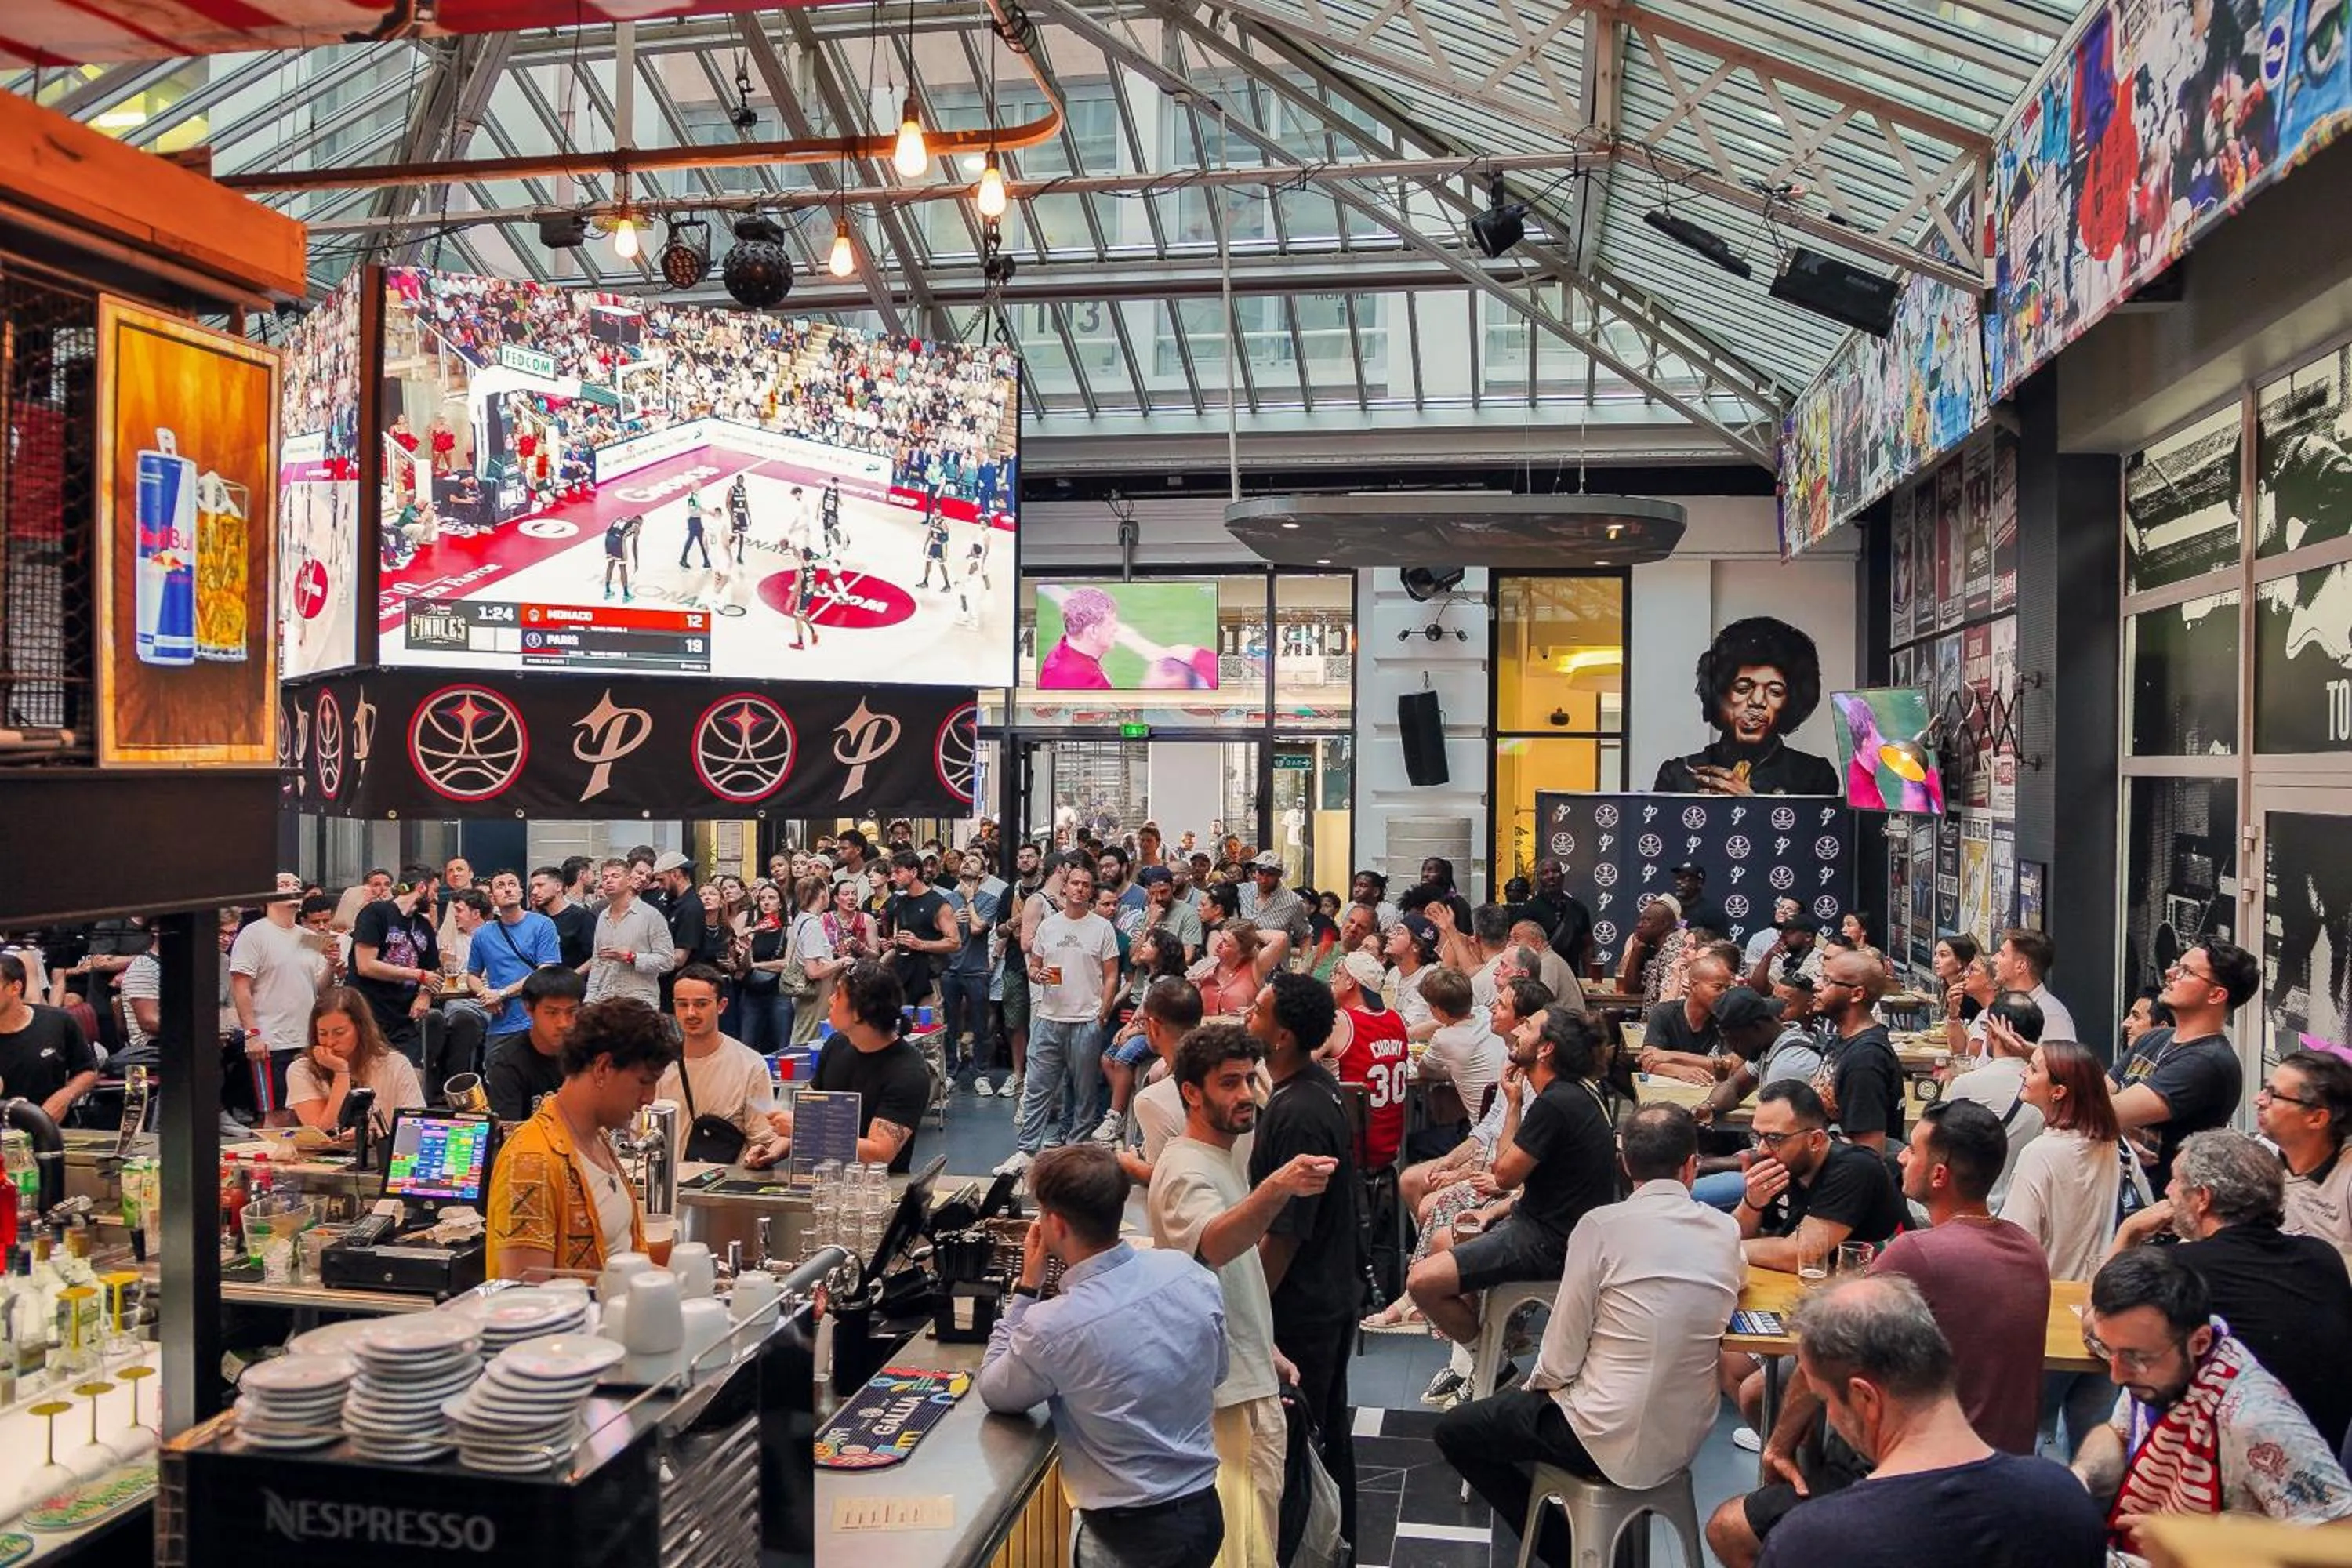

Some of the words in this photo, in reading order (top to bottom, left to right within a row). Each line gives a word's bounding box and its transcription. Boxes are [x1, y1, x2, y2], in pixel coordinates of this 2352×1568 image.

[505, 350, 550, 373] FEDCOM
[477, 605, 515, 622] 1:24
[546, 609, 593, 622] MONACO
[685, 614, 703, 628] 12
[546, 633, 579, 646] PARIS
[685, 639, 703, 653] 19
[1369, 1039, 1403, 1059] CURRY
[1367, 1061, 1408, 1108] 30
[871, 1396, 926, 1436] GALLIA
[260, 1486, 495, 1552] NESPRESSO
